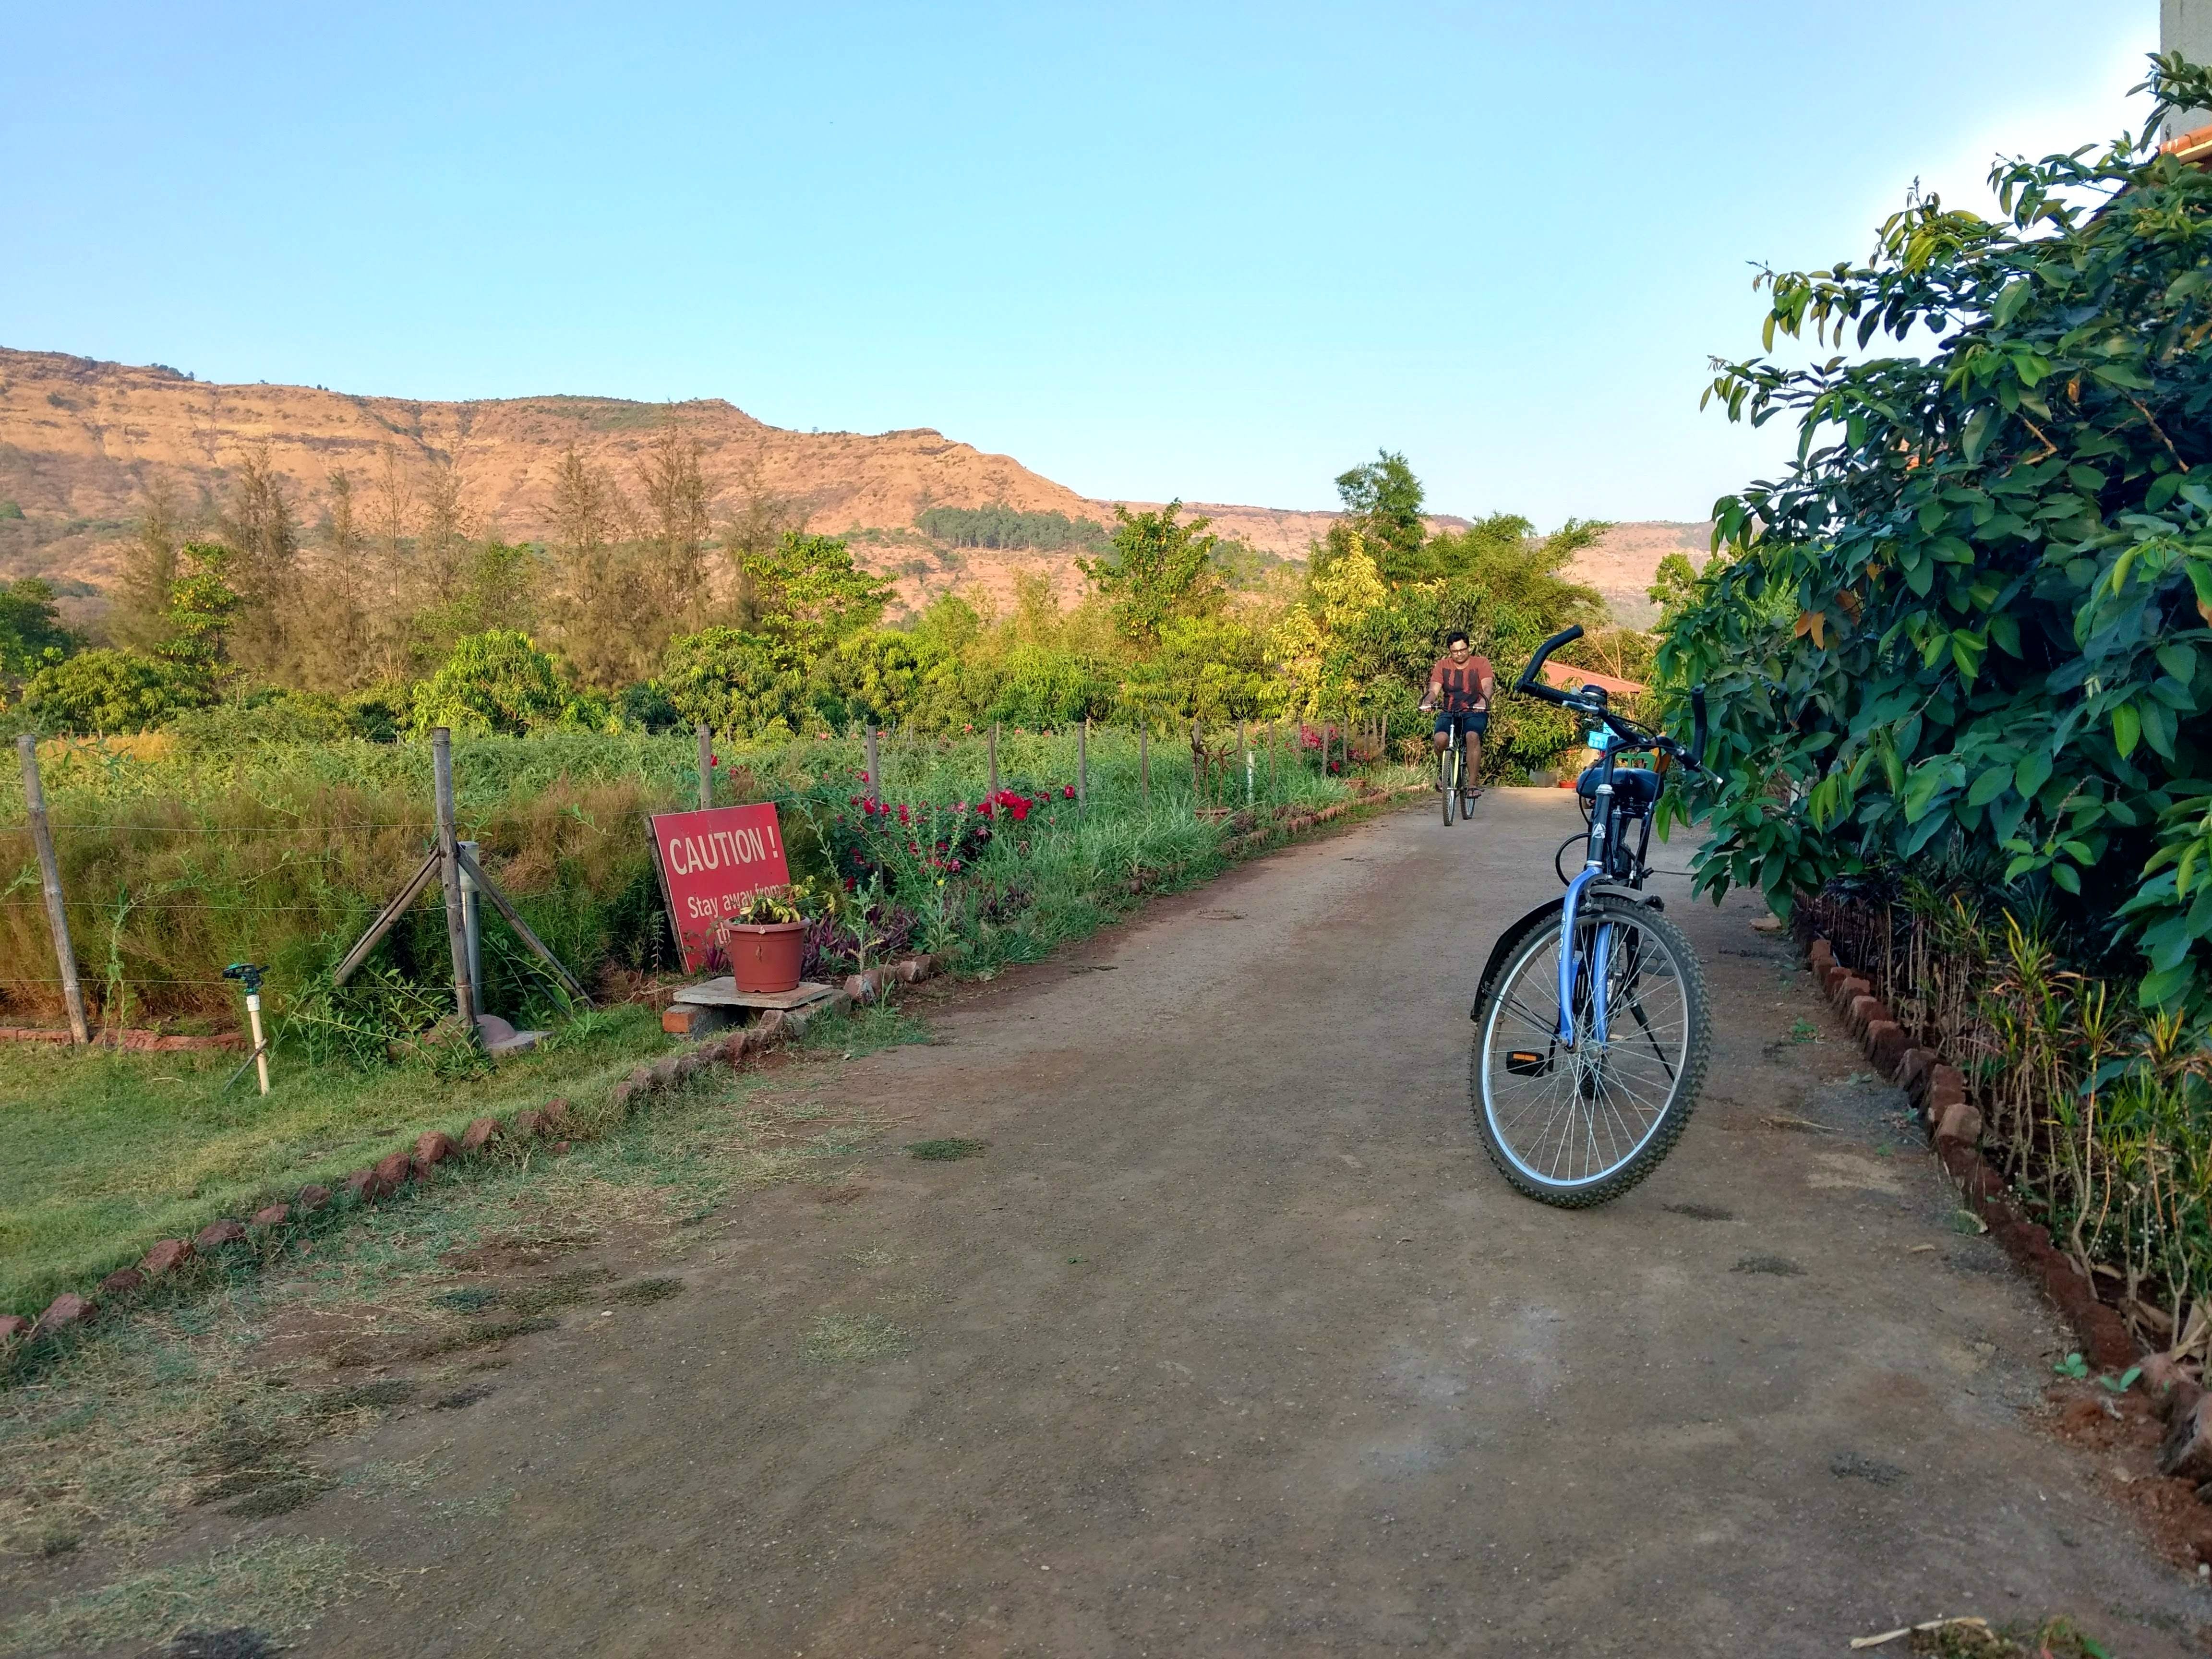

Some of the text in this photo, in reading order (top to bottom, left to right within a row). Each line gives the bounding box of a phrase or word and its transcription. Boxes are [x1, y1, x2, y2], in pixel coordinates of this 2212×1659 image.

[670, 827, 766, 876] CAUTION
[687, 895, 718, 918] Stay
[716, 922, 731, 944] th
